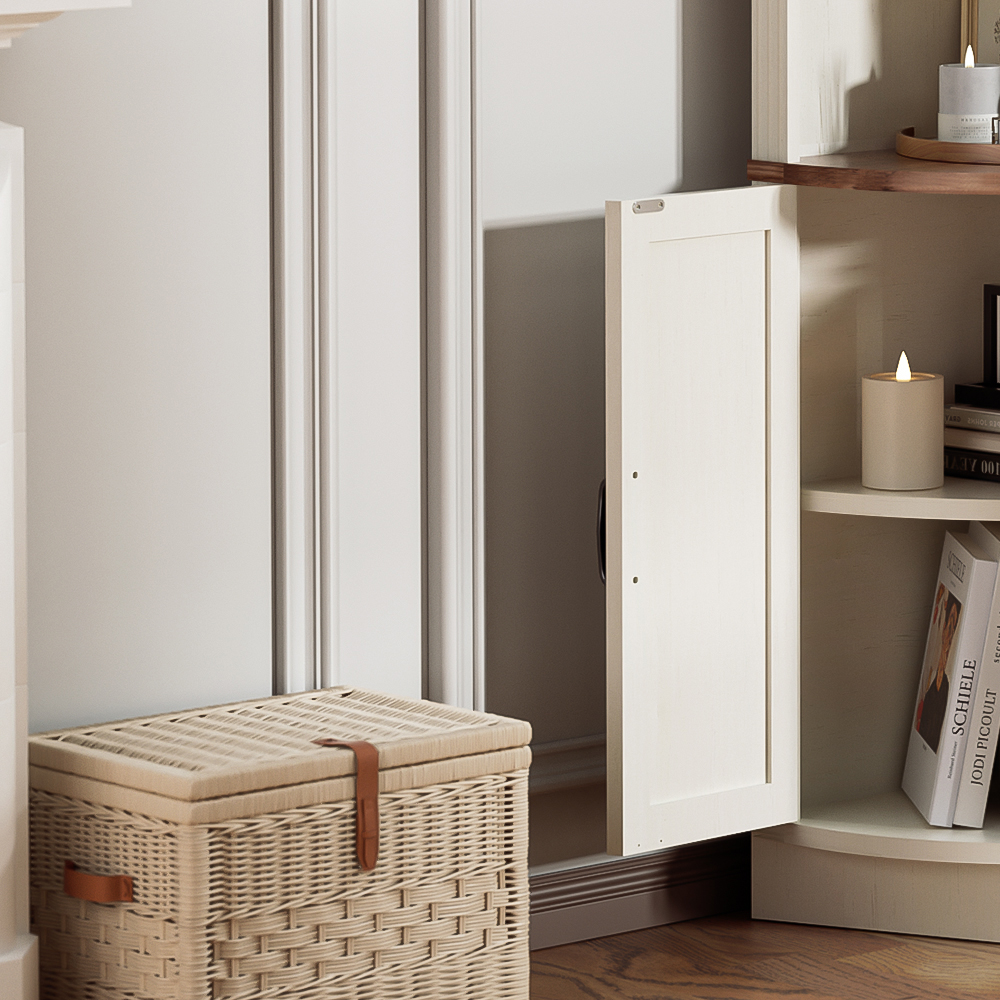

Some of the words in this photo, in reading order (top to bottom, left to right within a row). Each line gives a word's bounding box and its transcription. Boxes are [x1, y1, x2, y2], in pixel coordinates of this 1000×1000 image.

[951, 658, 977, 736] SCHIELE
[976, 688, 997, 750] PICOULT
[970, 754, 986, 786] JODI
